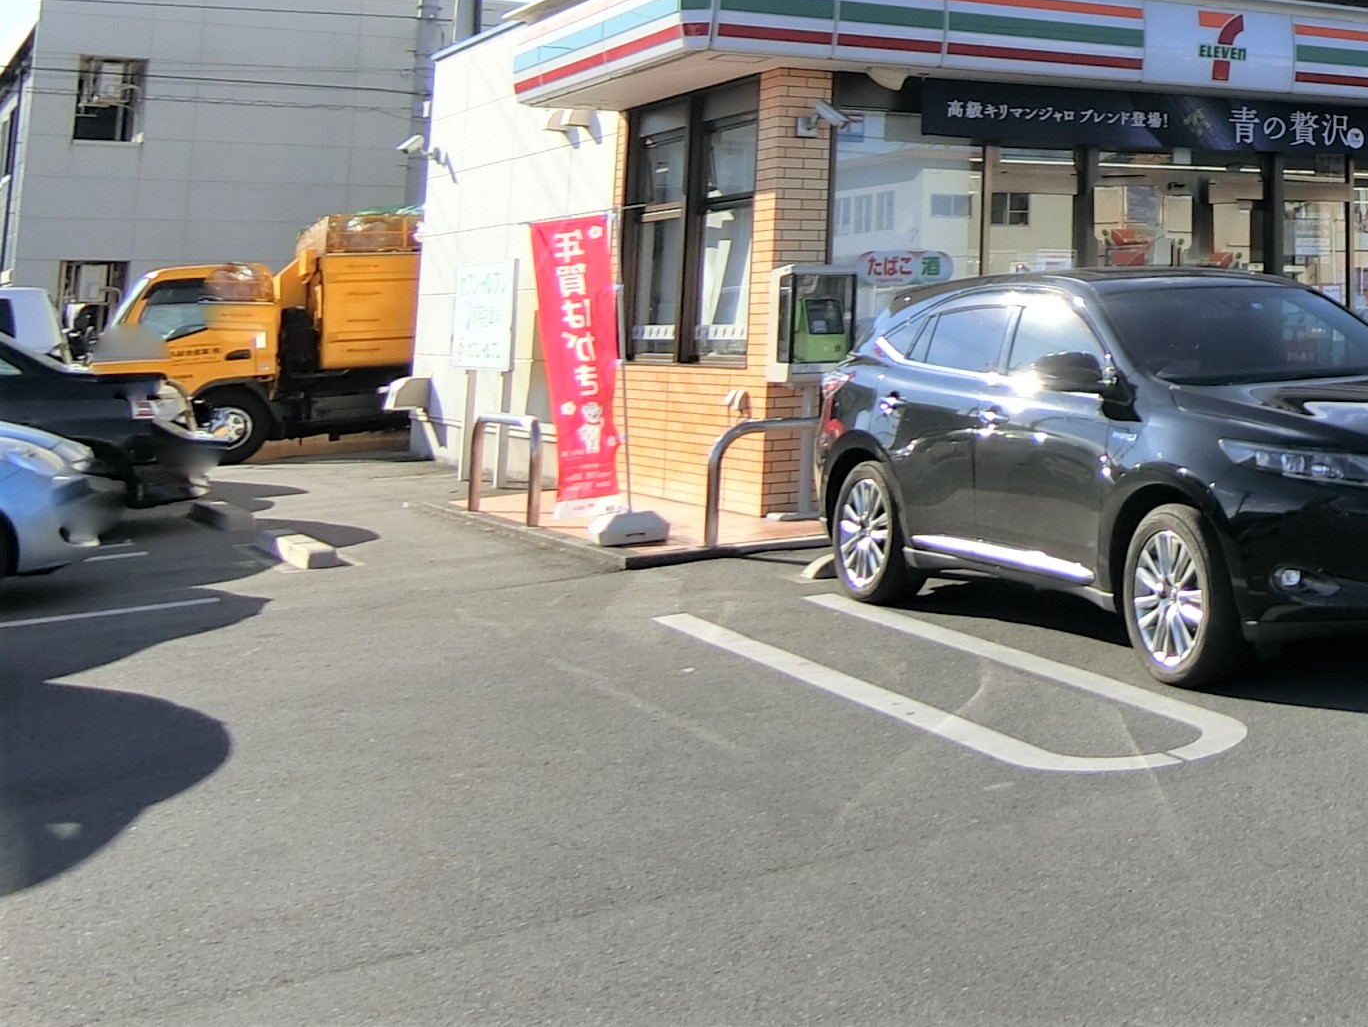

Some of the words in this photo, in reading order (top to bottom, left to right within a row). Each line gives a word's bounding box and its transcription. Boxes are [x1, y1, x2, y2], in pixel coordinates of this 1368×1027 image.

[1228, 104, 1351, 147] 青の贅沢
[867, 255, 913, 276] たばこ
[920, 256, 941, 276] 酒
